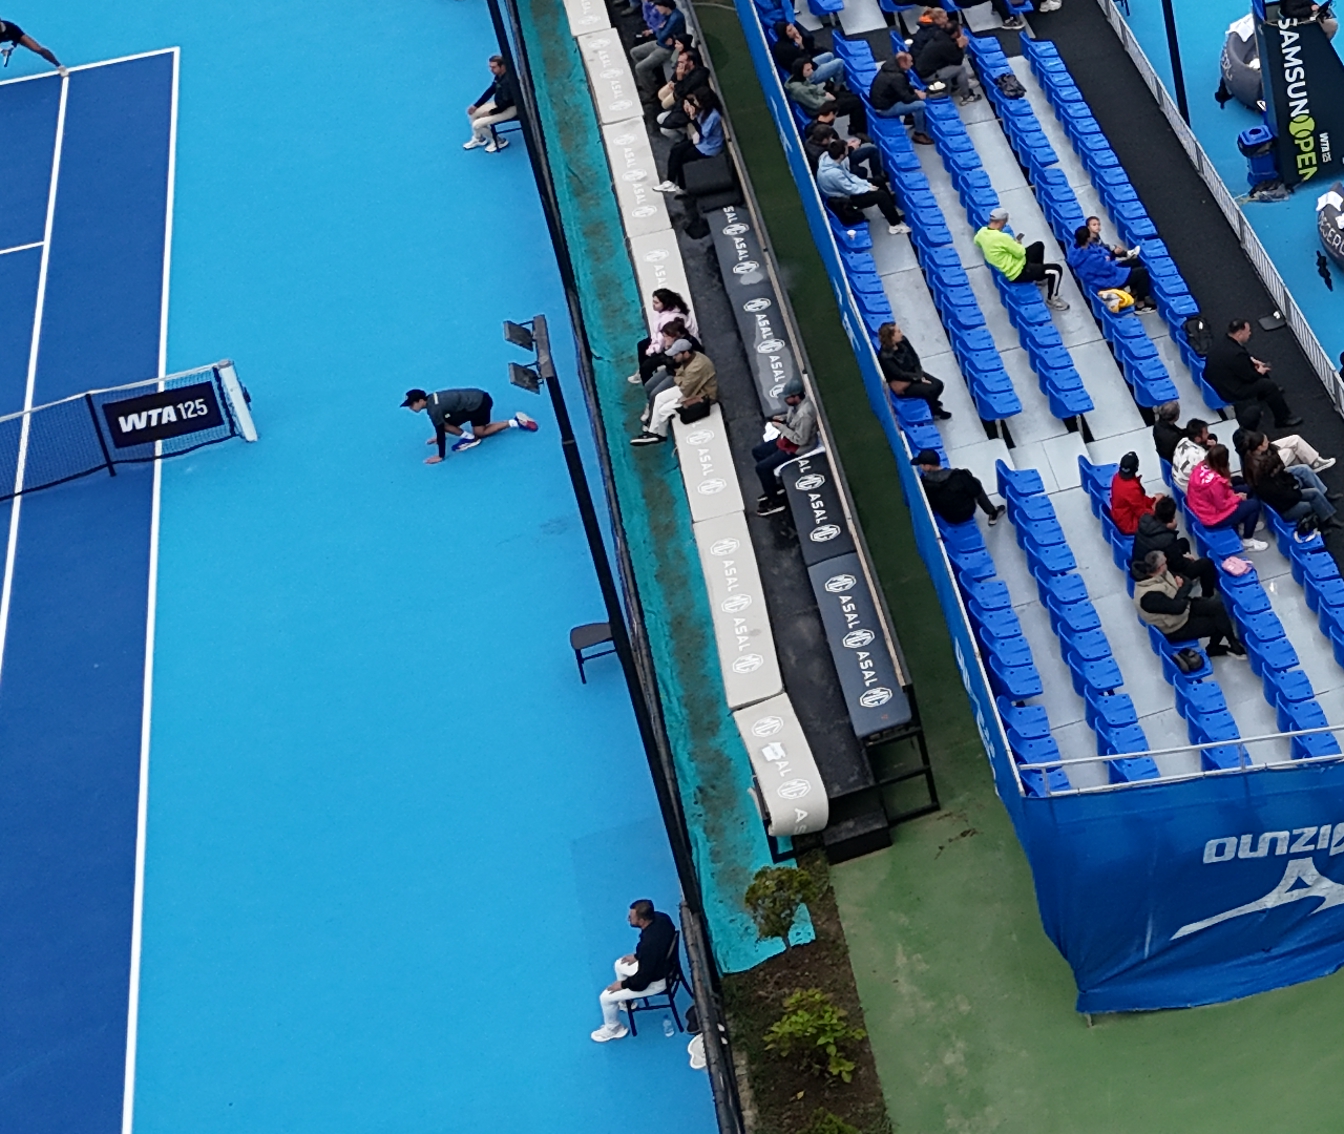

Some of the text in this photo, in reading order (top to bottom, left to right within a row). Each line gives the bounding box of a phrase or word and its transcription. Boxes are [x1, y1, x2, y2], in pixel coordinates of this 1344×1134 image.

[733, 237, 750, 263] ASAL
[756, 313, 775, 340] ASAL
[769, 355, 787, 383] ASAL
[118, 398, 209, 434] WTA 125
[698, 448, 714, 477] ASAL
[808, 493, 829, 525] ASAL
[722, 560, 740, 593] ASAL
[838, 595, 861, 629] ASAL
[733, 617, 751, 652] ASAL
[856, 652, 880, 687] ASAL
